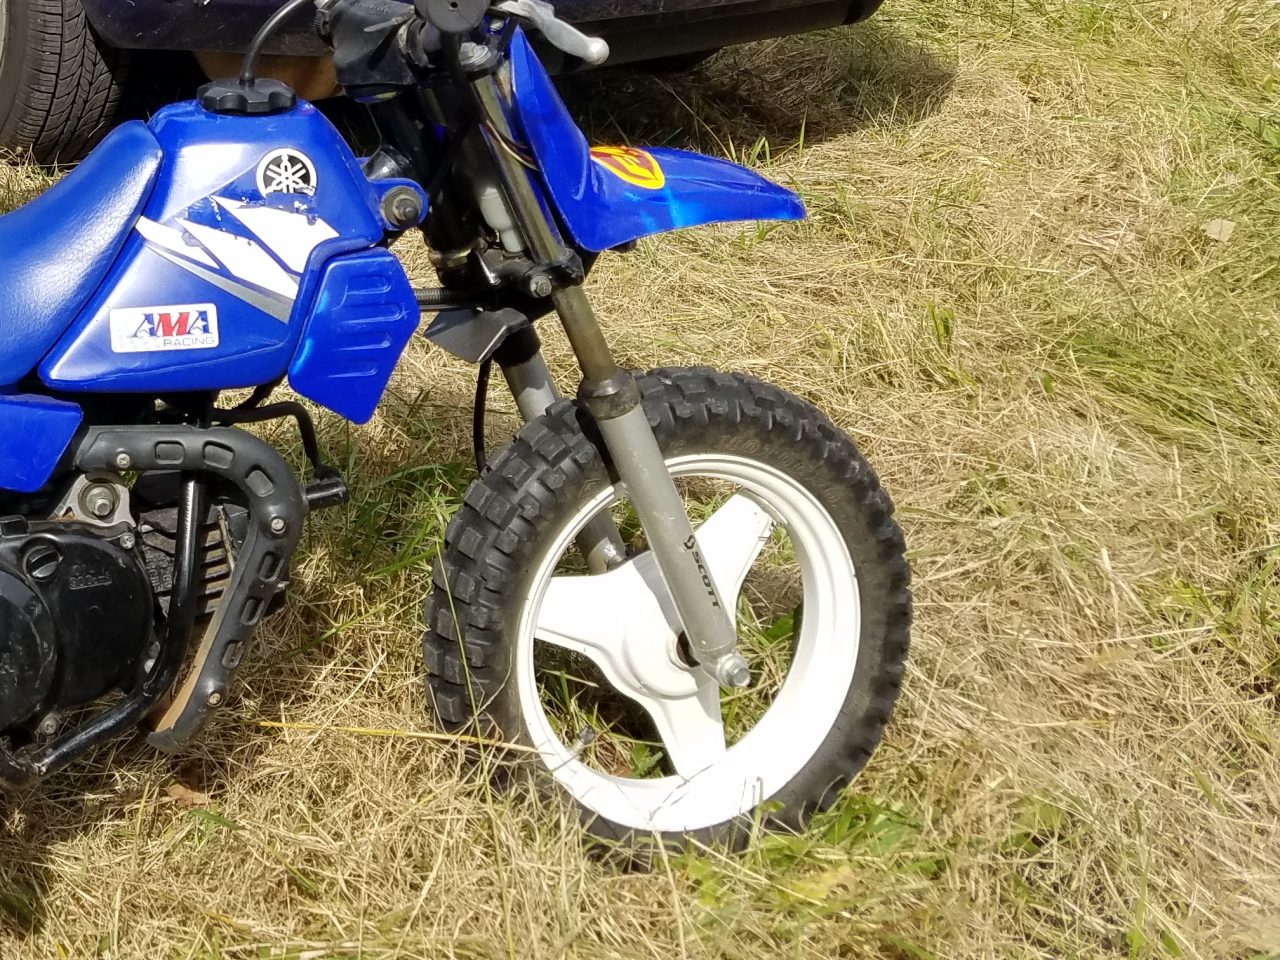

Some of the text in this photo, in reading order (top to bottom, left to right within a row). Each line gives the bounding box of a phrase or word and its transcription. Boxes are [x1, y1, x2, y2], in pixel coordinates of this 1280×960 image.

[132, 310, 213, 337] AMA
[163, 337, 215, 347] RACING
[691, 551, 721, 608] SCOTT
